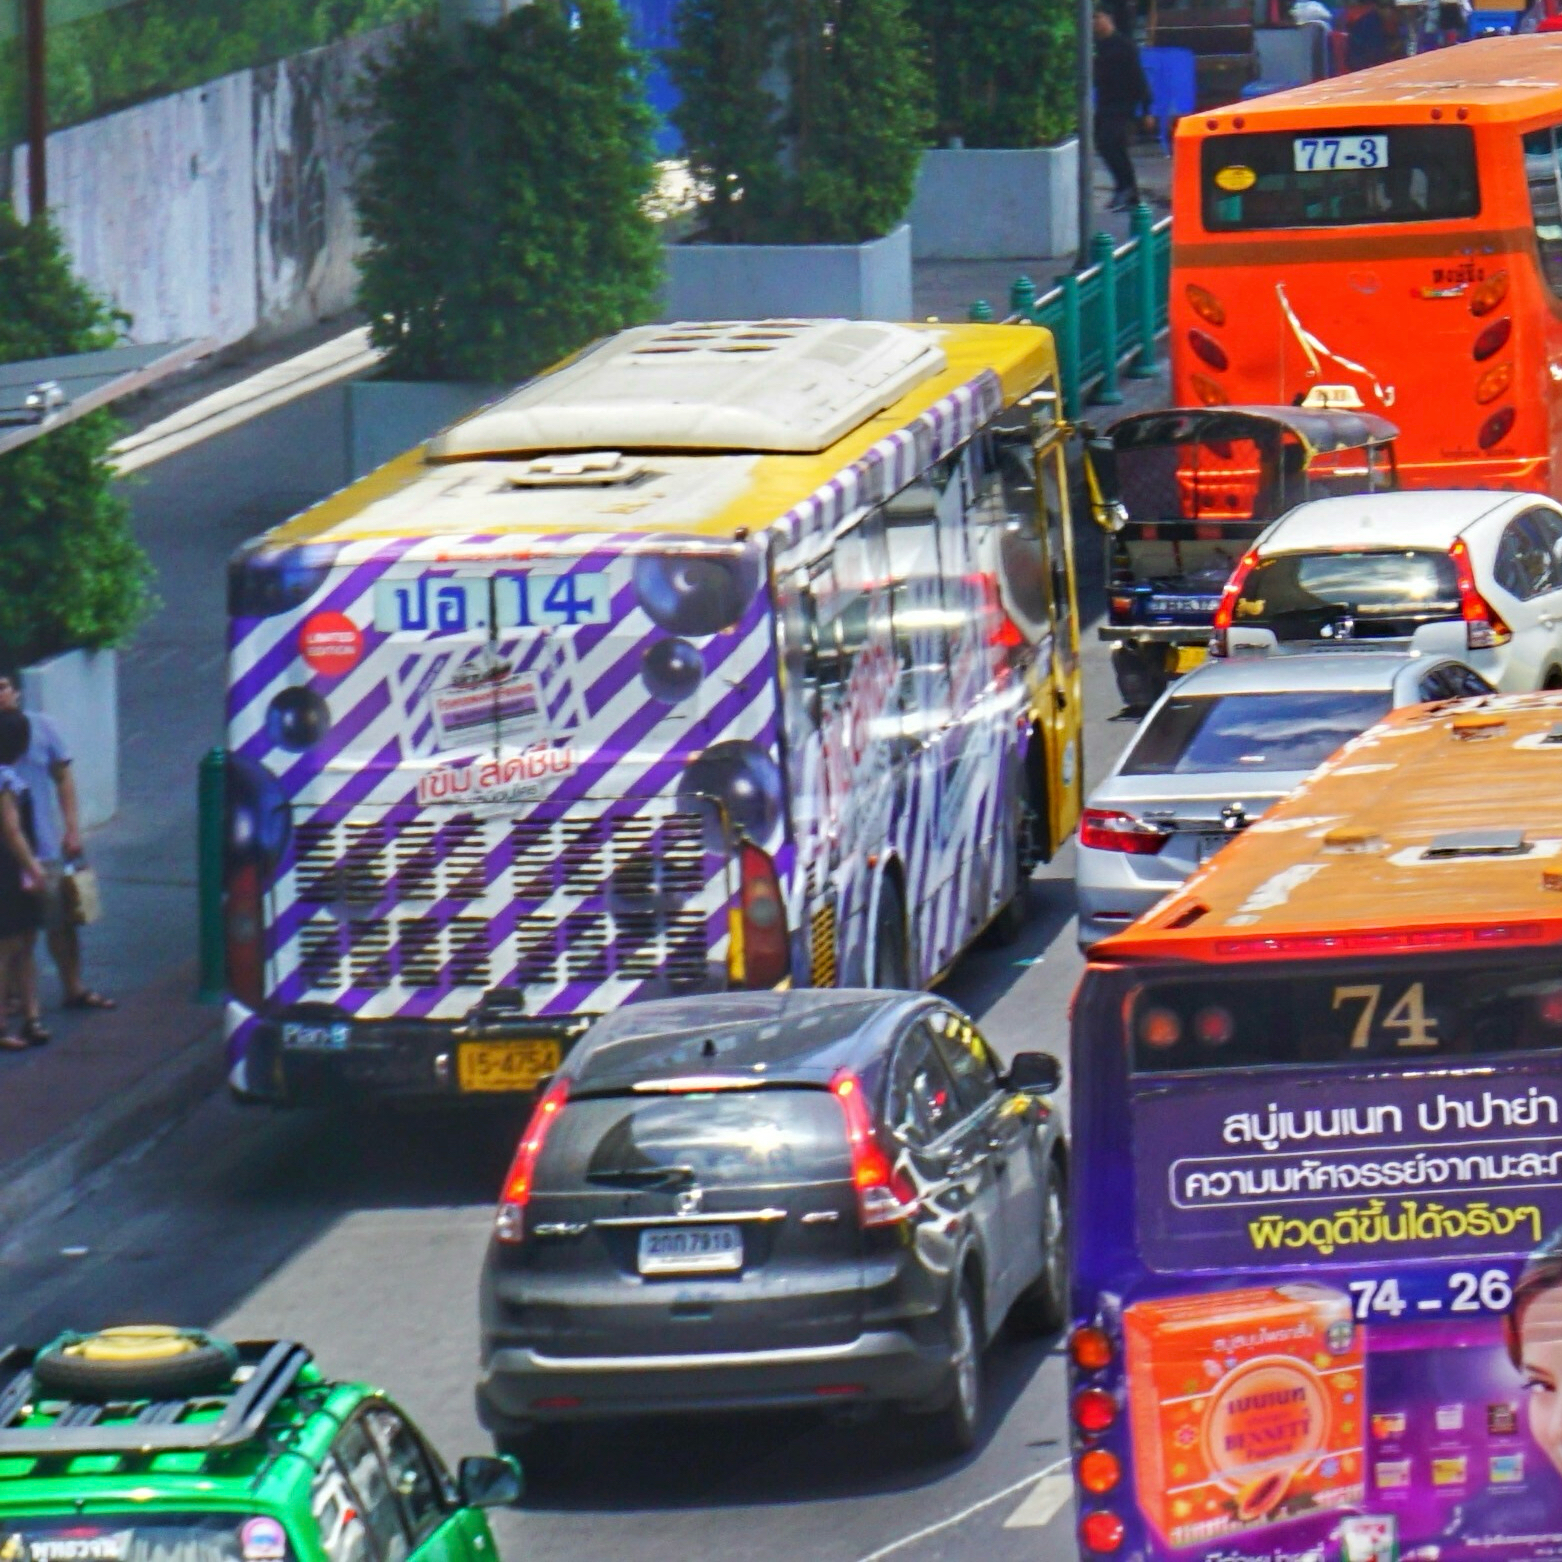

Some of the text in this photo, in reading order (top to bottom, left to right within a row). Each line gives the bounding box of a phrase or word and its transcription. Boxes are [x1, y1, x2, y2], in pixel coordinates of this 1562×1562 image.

[1301, 139, 1379, 169] 77-3
[512, 574, 594, 627] 14
[1331, 982, 1439, 1049] 74
[1223, 1087, 1559, 1151] สบู่เบนเนท ปาปาย่า
[1249, 1198, 1541, 1254] ผิวดูดีขึ้นได้จริงๆ
[1350, 1279, 1406, 1318] 74
[1448, 1270, 1513, 1314] 26
